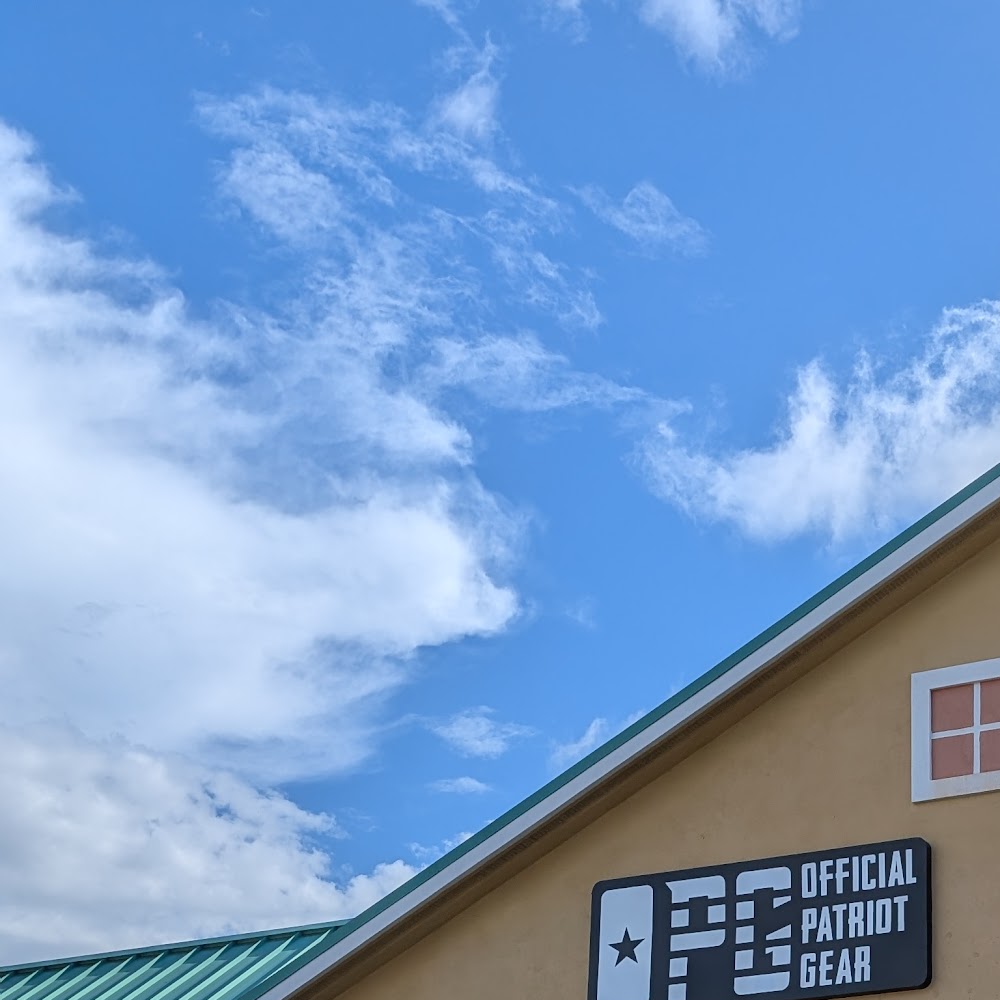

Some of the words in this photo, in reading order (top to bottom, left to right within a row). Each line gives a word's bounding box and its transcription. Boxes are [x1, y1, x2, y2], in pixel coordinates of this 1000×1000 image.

[801, 849, 916, 899] OFFICIAL
[801, 895, 908, 944] PATRIOT
[800, 946, 871, 988] GEAR
